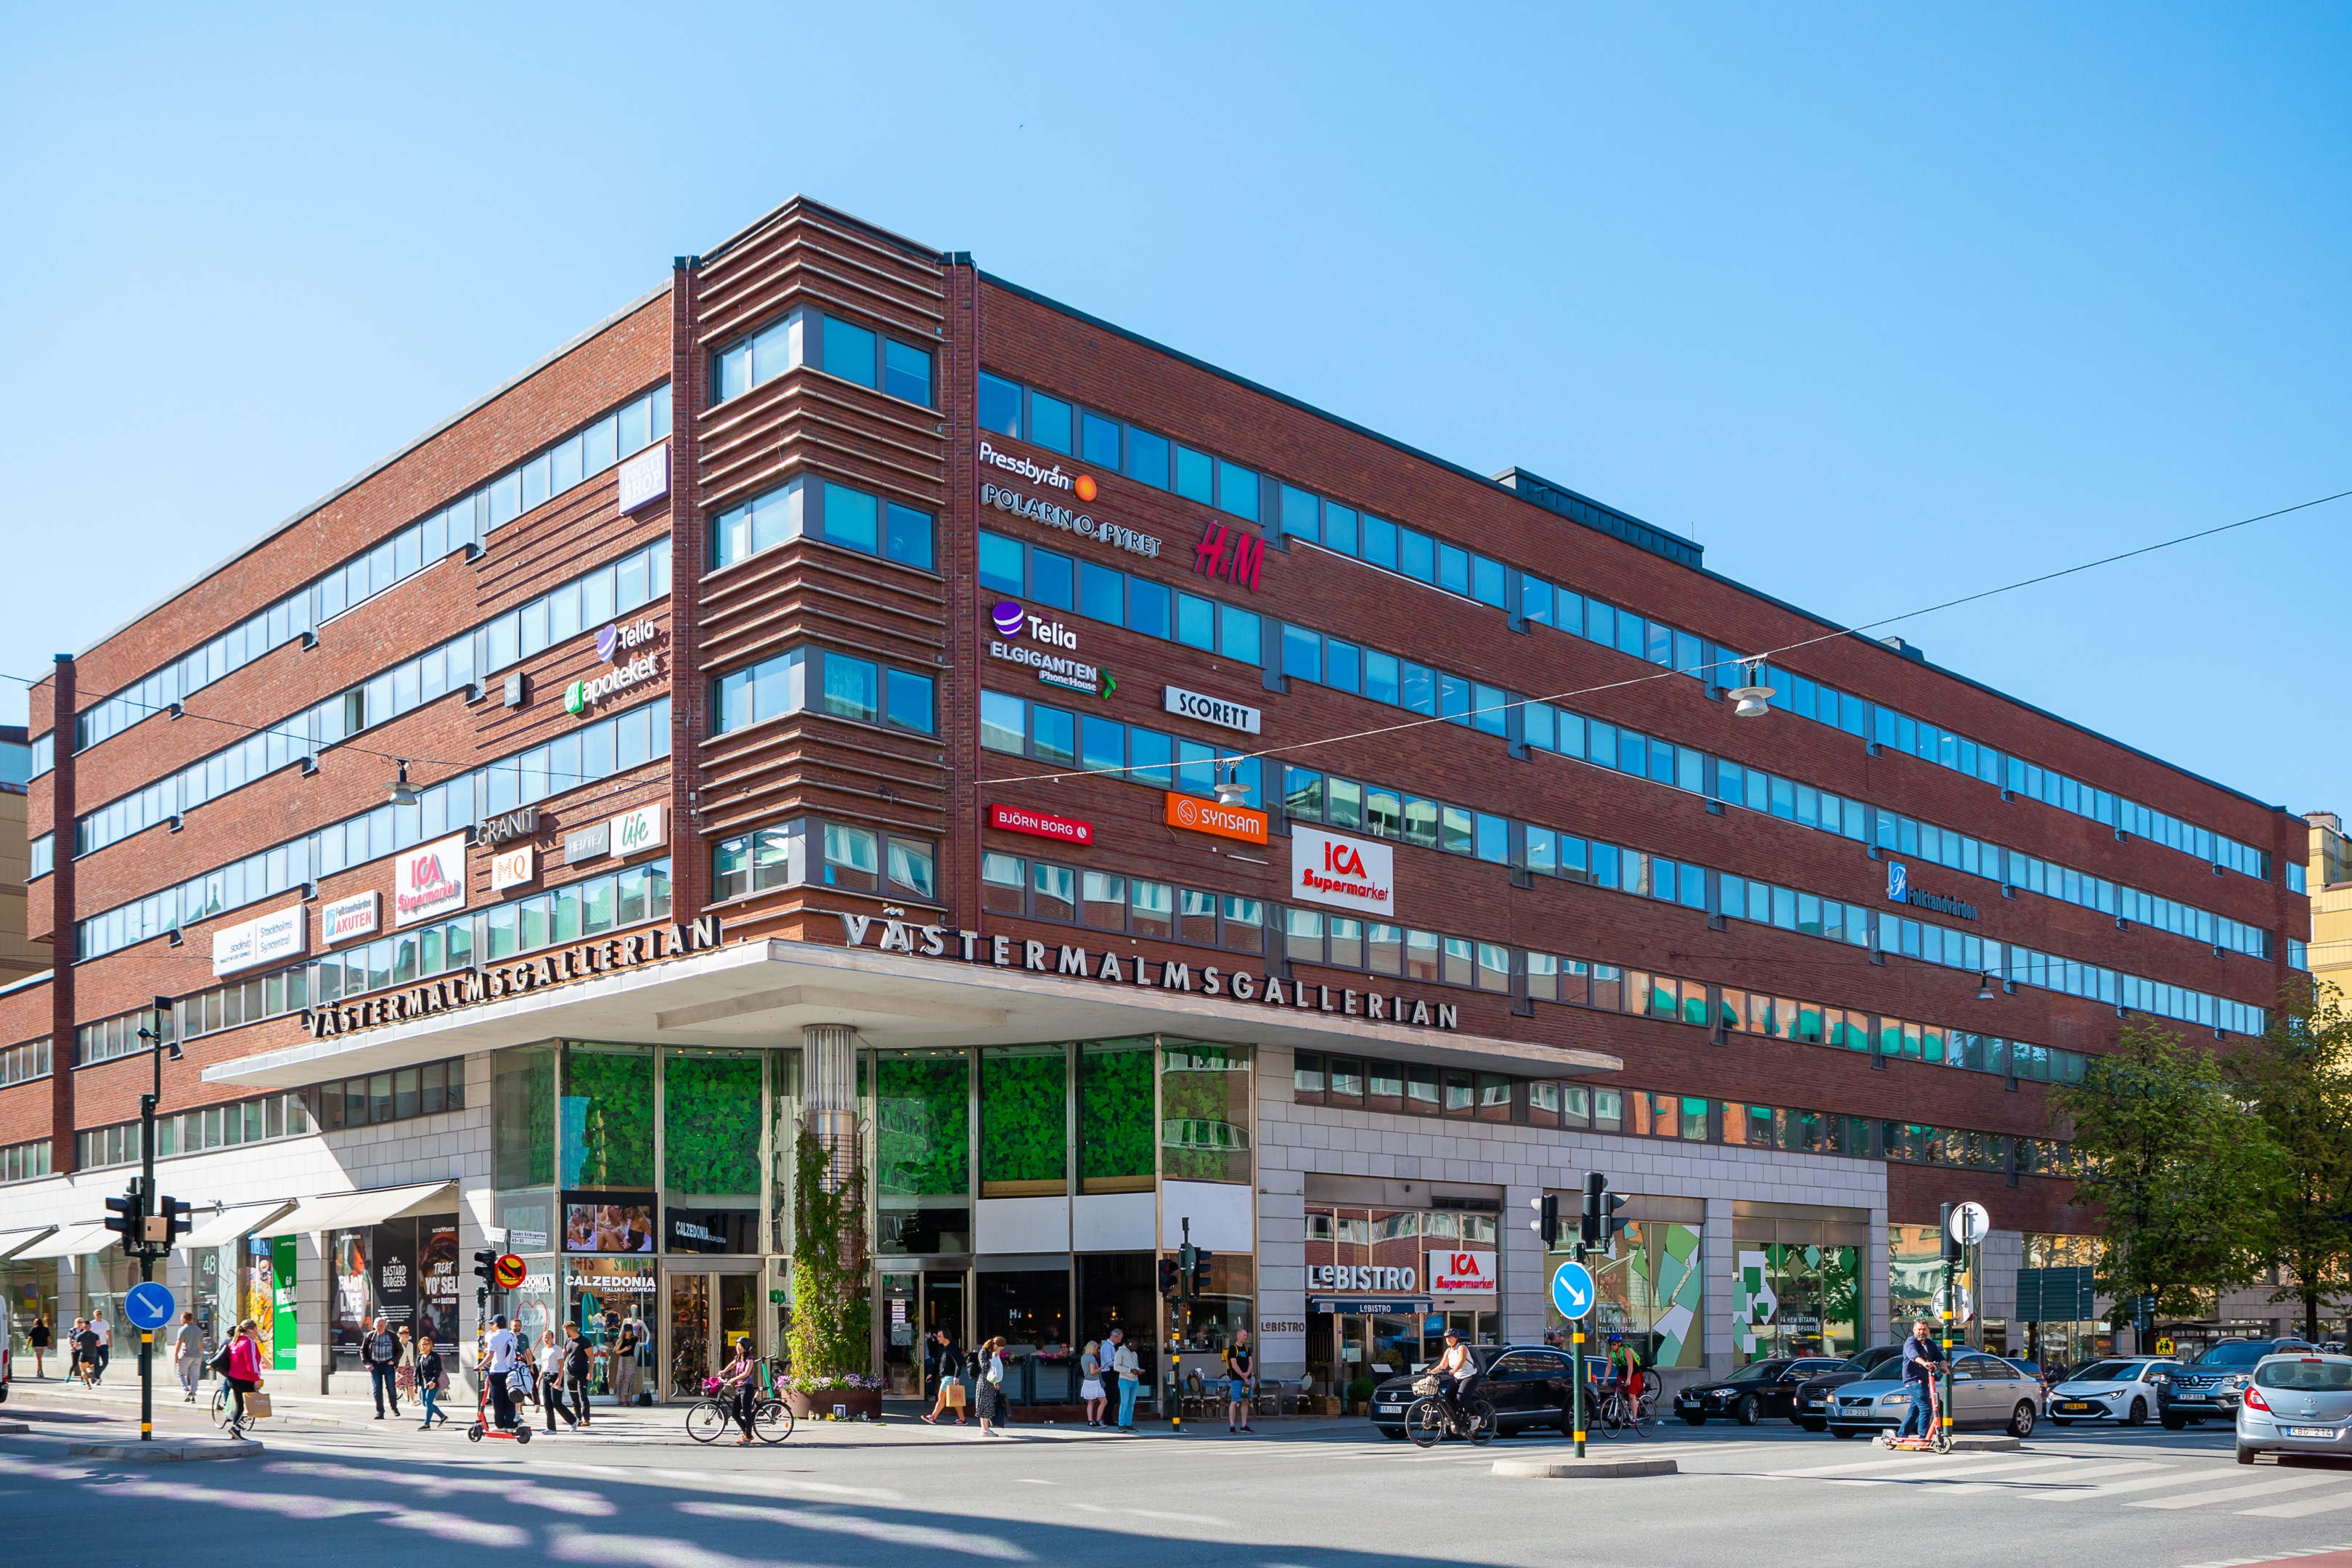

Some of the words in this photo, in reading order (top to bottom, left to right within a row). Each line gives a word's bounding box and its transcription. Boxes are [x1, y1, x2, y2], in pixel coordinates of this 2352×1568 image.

[979, 441, 1069, 491] Pressbyrån
[624, 468, 661, 502] SHOP
[985, 483, 1072, 529] POLARN
[1106, 523, 1161, 557] PYRET
[1195, 521, 1265, 593] H&M
[618, 618, 654, 649] Telia
[1027, 616, 1077, 650] Telia
[990, 641, 1097, 682] ELGIGANTEN
[506, 680, 518, 690] NOA
[582, 651, 658, 705] apoteket
[506, 688, 518, 698] NOA
[1179, 692, 1249, 729] SCORETT
[476, 809, 534, 846] GRANIT
[622, 812, 648, 848] life
[999, 811, 1038, 829] BJÖRN
[1041, 821, 1073, 836] BORG
[1201, 807, 1259, 835] SYNSAM
[412, 854, 441, 889] ICA
[498, 854, 526, 882] MQ
[1325, 841, 1368, 879] ICA
[398, 880, 457, 911] Supermarket
[1303, 869, 1389, 901] Supermarket
[1907, 886, 1977, 921] Folktandvården
[261, 920, 293, 937] Stockholms
[336, 910, 372, 934] AKUTEN
[261, 934, 290, 953] Syncentral
[307, 915, 722, 1038] VÄSTERMALMSGALLERIAN
[838, 907, 1458, 1029] VÄSTERMALMSGALLERIAN
[676, 1221, 709, 1240] CALZEDONIA
[203, 1254, 216, 1275] 48
[383, 1265, 407, 1277] BASTARD
[434, 1262, 454, 1275] TREAT
[1451, 1254, 1479, 1275] ICA
[285, 1276, 292, 1286] GO
[338, 1274, 363, 1291] ENJOY
[383, 1276, 407, 1288] BURGERS
[564, 1275, 656, 1287] CALZEDONIA
[1436, 1275, 1495, 1291] Supermarket
[276, 1286, 297, 1306] VEGA
[340, 1292, 362, 1312] LIFE
